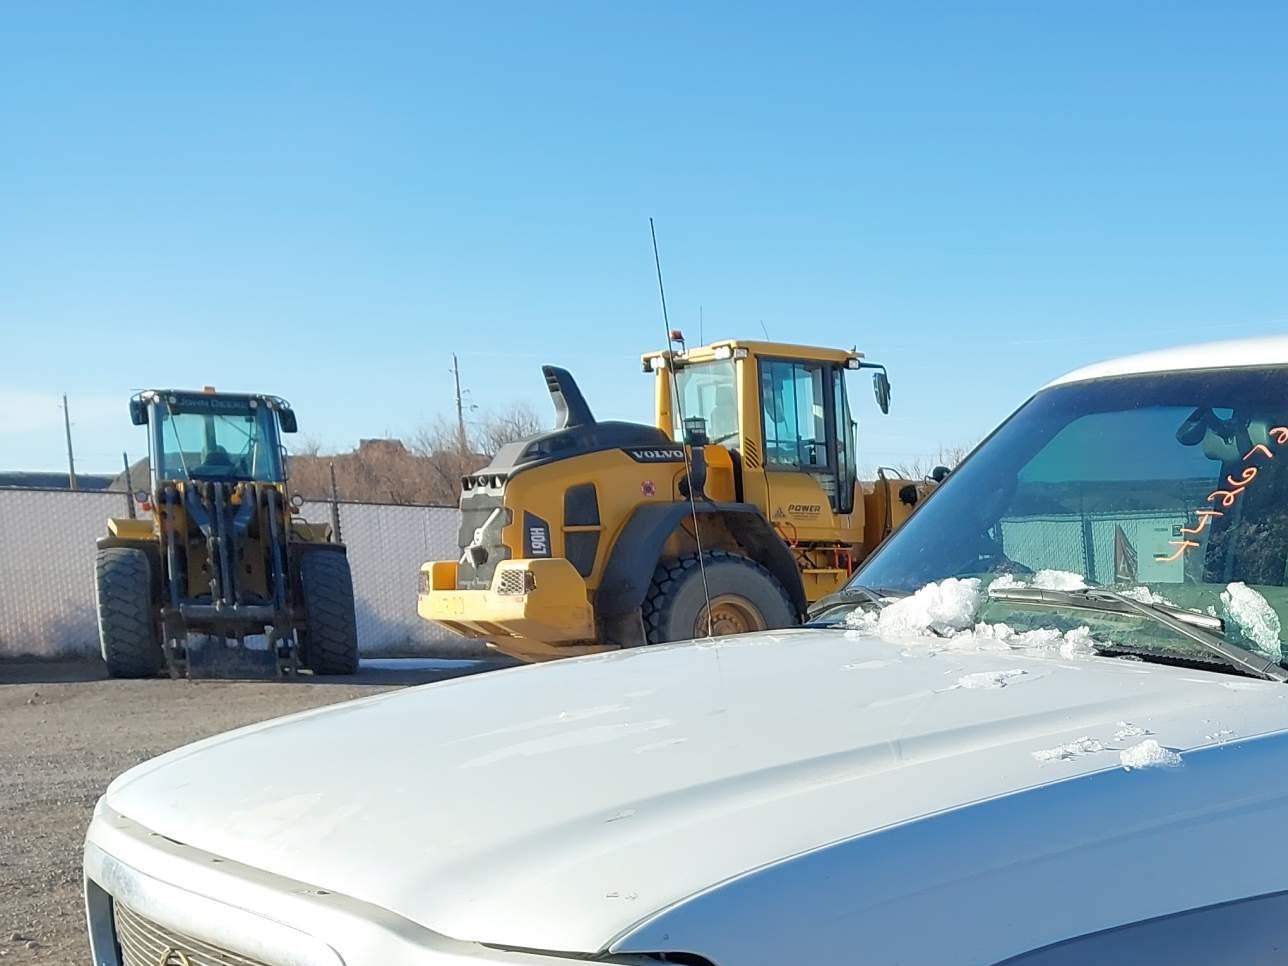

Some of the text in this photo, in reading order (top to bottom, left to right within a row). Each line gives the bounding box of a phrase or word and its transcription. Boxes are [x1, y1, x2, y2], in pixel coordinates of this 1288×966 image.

[632, 450, 684, 458] VOLVO
[788, 504, 821, 512] POWER
[530, 527, 547, 554] L90H
